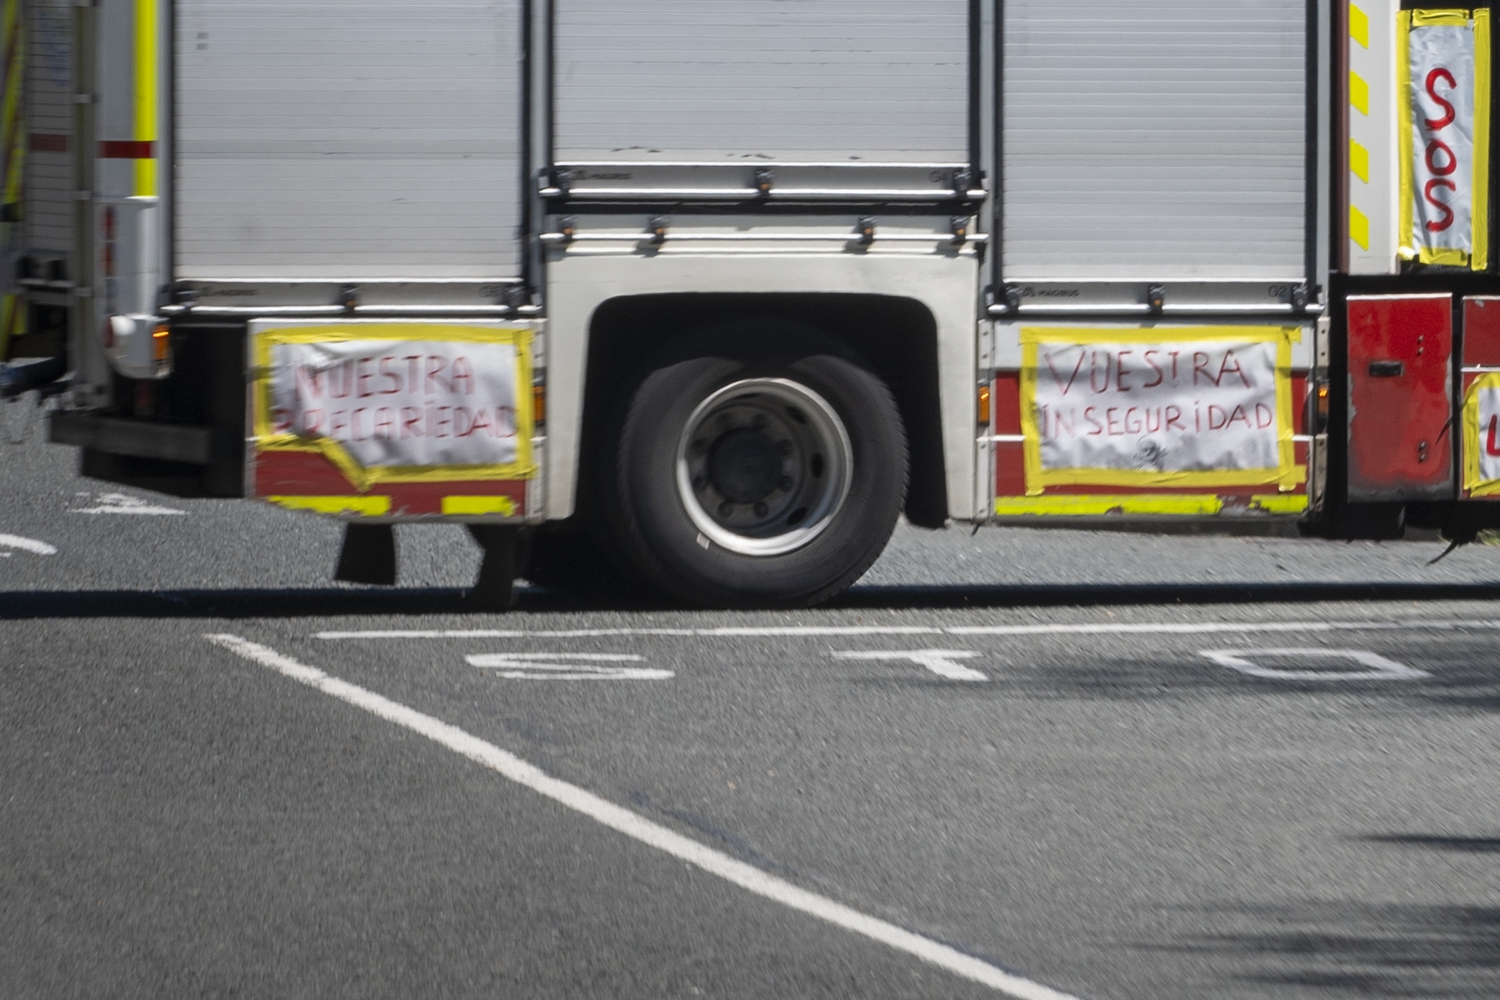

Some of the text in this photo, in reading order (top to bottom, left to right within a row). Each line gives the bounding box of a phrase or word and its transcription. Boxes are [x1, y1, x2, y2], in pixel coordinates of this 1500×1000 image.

[1424, 67, 1457, 232] SOS
[1268, 284, 1287, 297] G2
[296, 354, 475, 399] NUESTRA
[1045, 350, 1250, 395] VUESTRA
